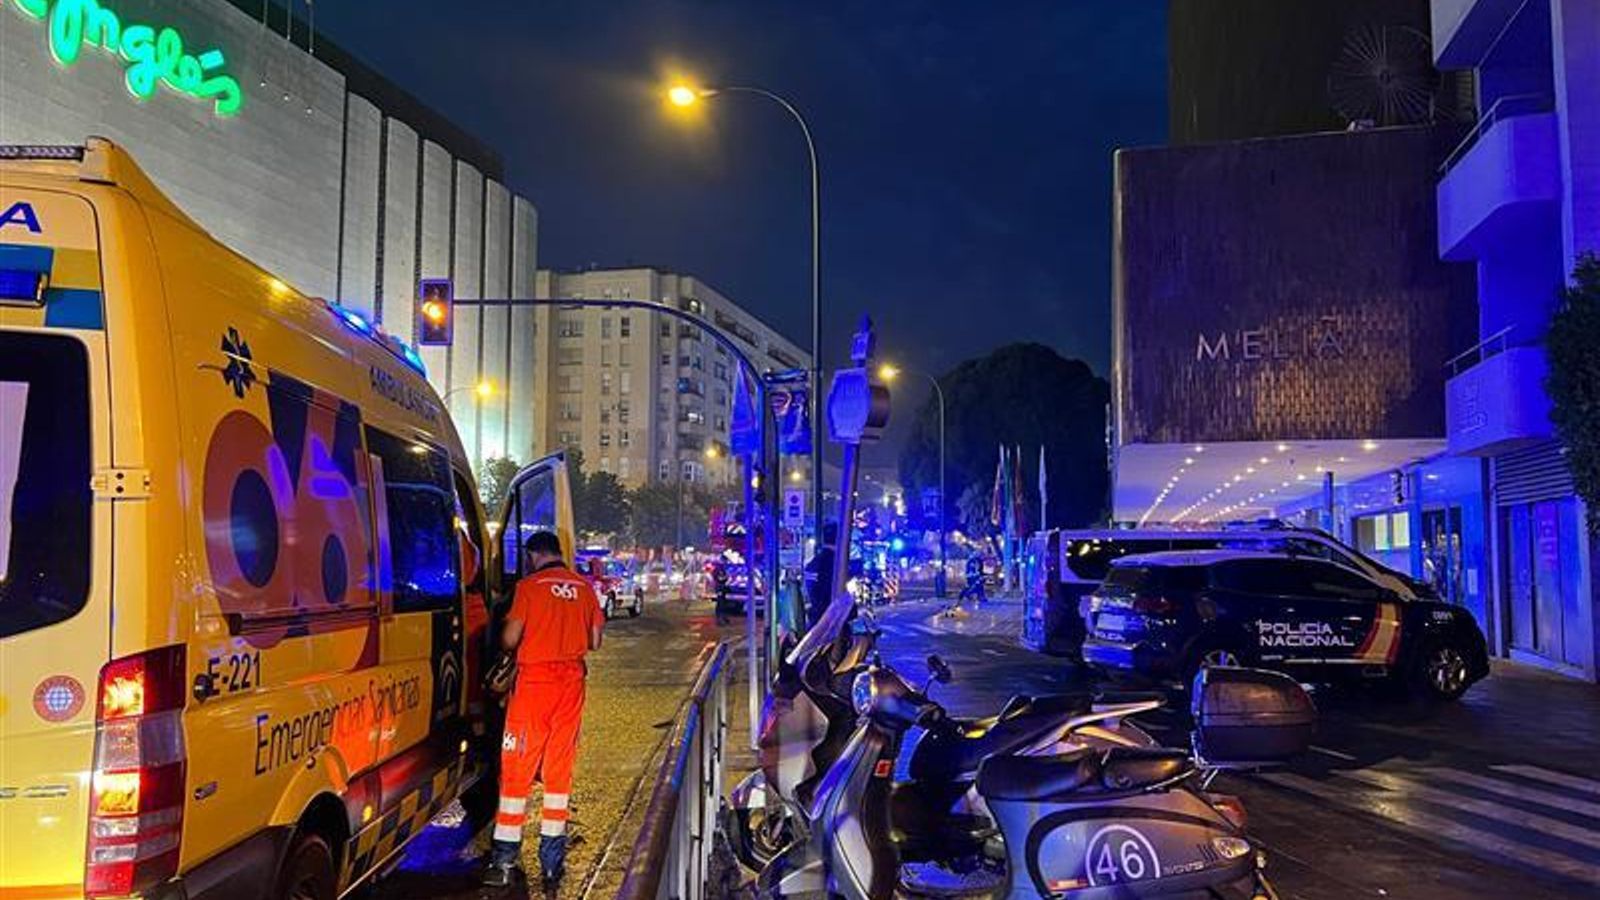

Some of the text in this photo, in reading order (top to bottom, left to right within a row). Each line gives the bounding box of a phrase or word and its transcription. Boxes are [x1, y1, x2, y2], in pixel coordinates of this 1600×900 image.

[550, 583, 578, 600] 061
[1260, 635, 1354, 646] NACIONAL
[208, 650, 261, 697] E-221
[1096, 840, 1144, 881] 46
